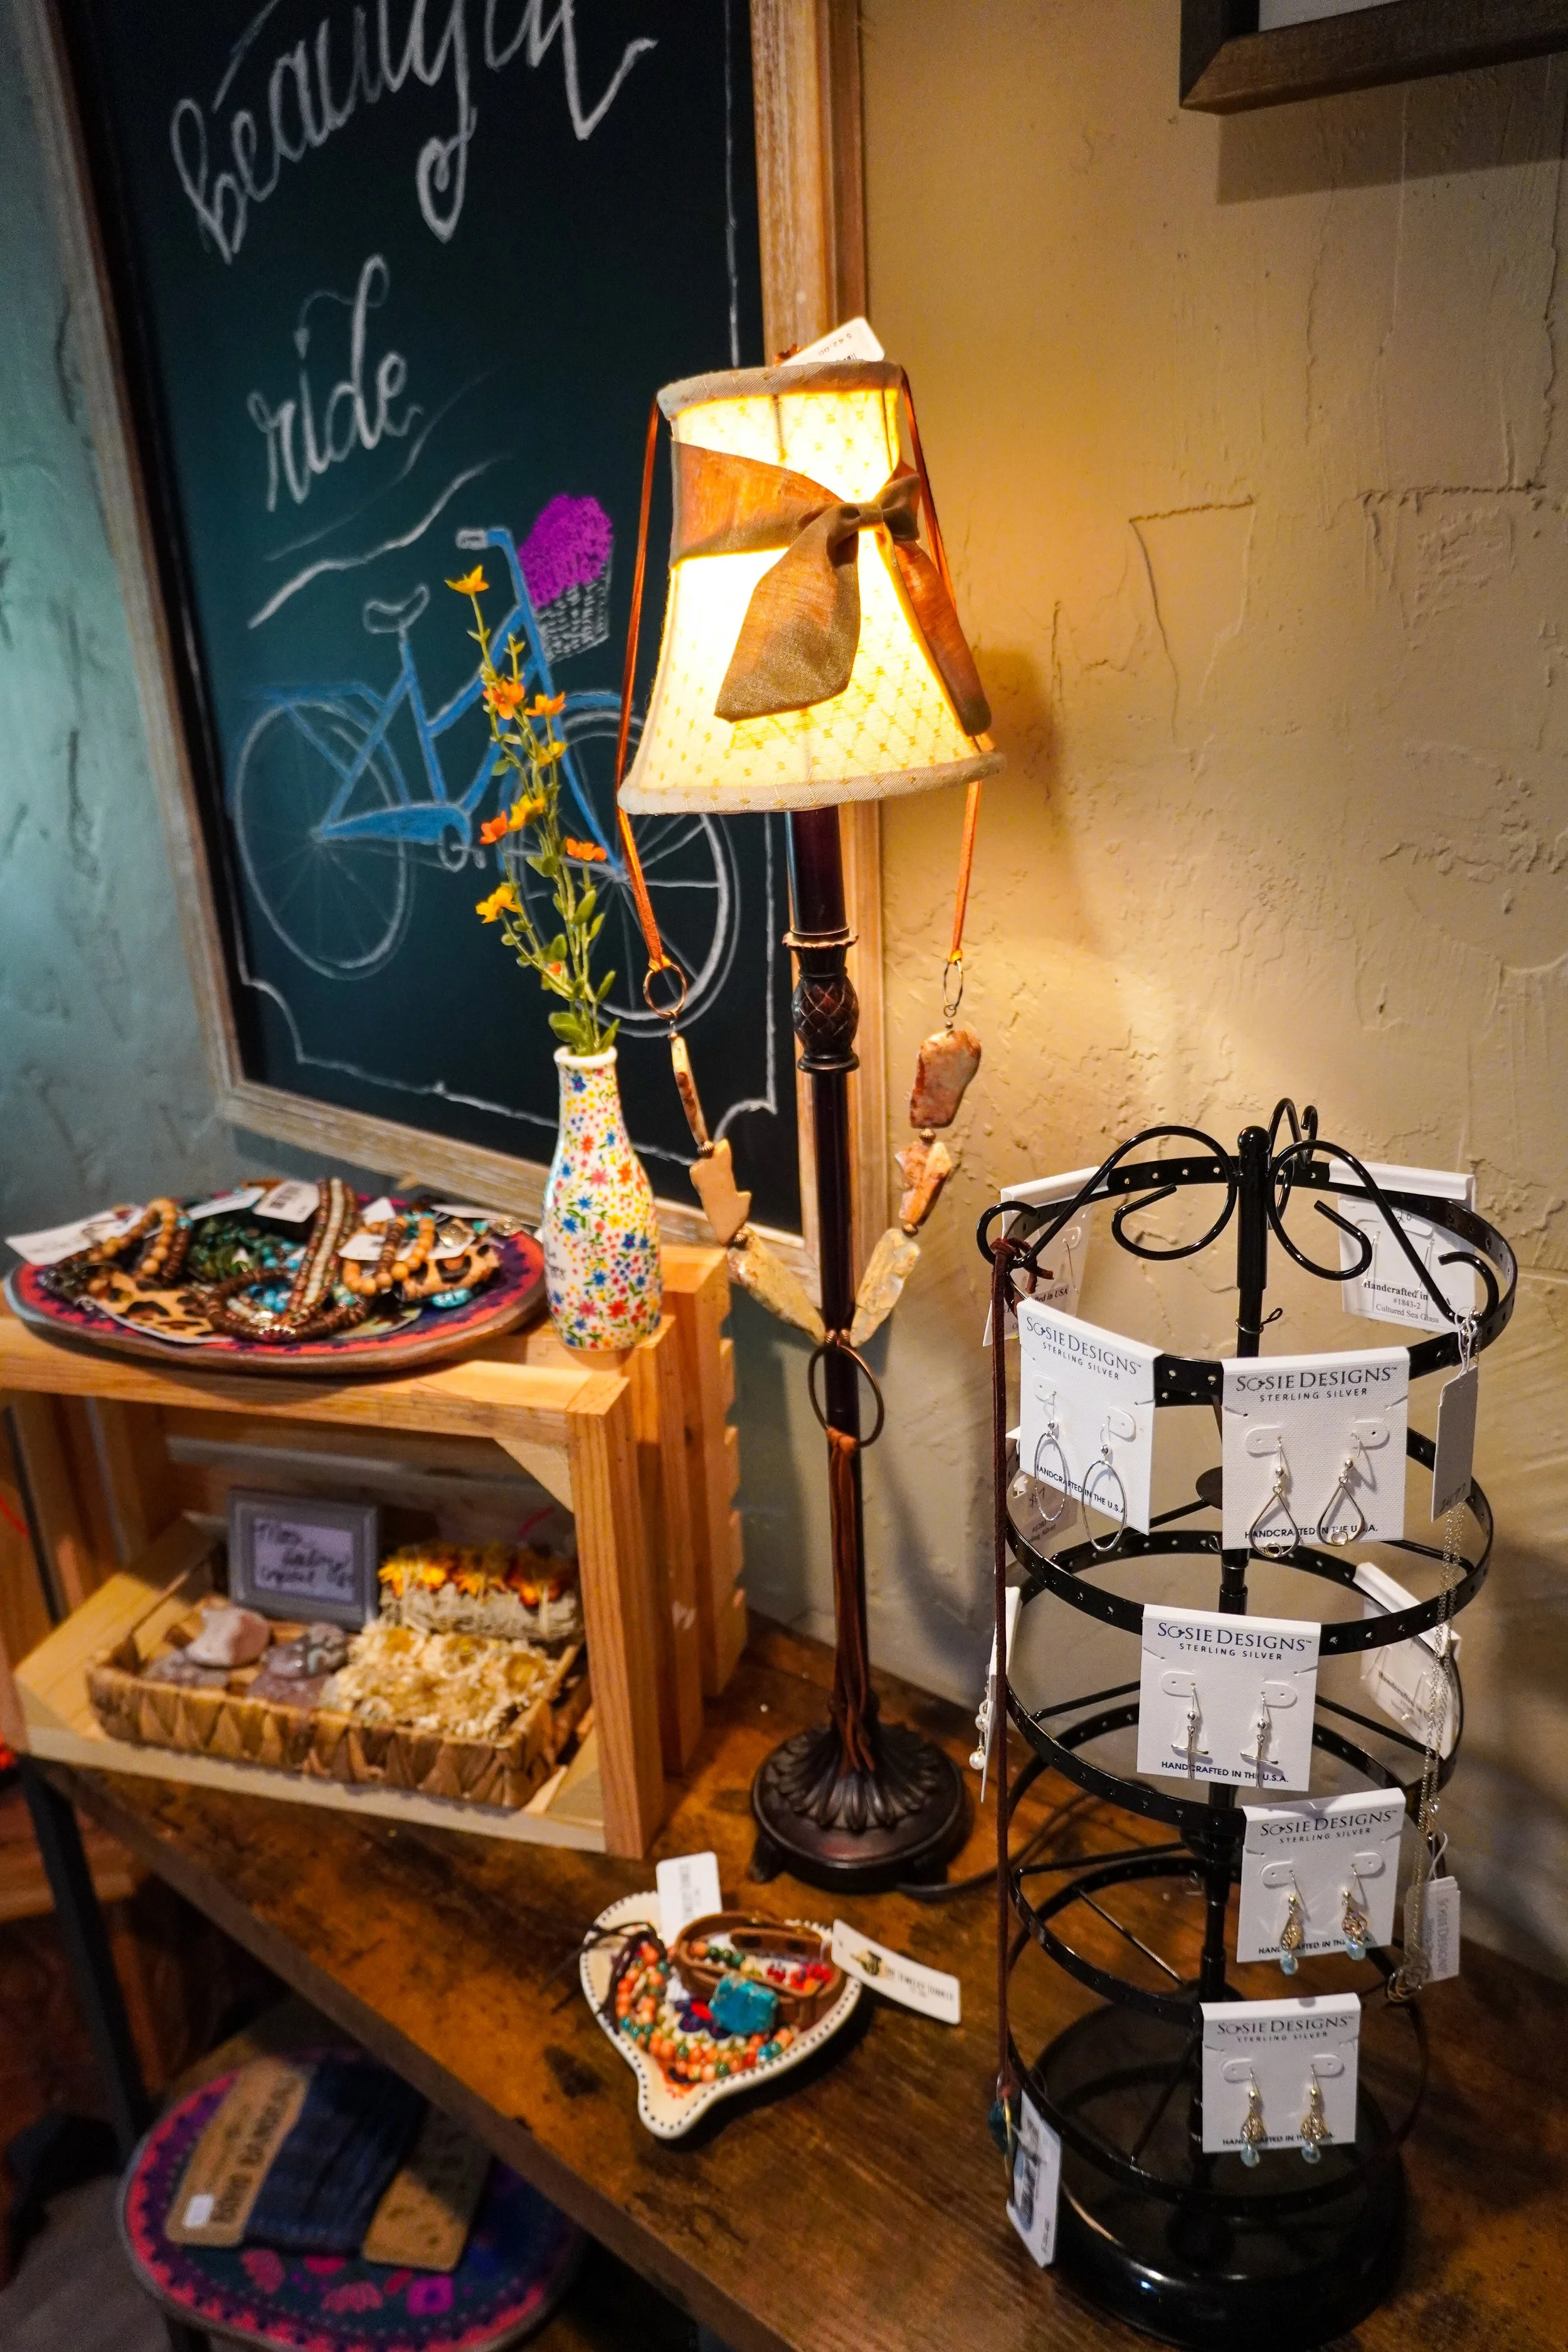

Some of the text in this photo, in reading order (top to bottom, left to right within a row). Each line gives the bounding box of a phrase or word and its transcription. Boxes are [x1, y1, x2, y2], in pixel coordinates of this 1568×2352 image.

[247, 254, 424, 512] ride
[1364, 1280, 1417, 1299] Handcrafted
[1393, 1297, 1421, 1310] #1843-2
[1375, 1303, 1439, 1324] Cultured Sea Glass
[1036, 1464, 1083, 1493] ANDCRFTED
[1084, 1489, 1092, 1498] IN
[1093, 1493, 1106, 1505] THE
[1244, 1527, 1316, 1539] HANDCRATED
[1231, 1770, 1242, 1778] IN
[1263, 1774, 1289, 1783] U.S.A.
[1258, 1942, 1320, 1954] HANAFTED
[1222, 2136, 1283, 2145] HANAFTED
